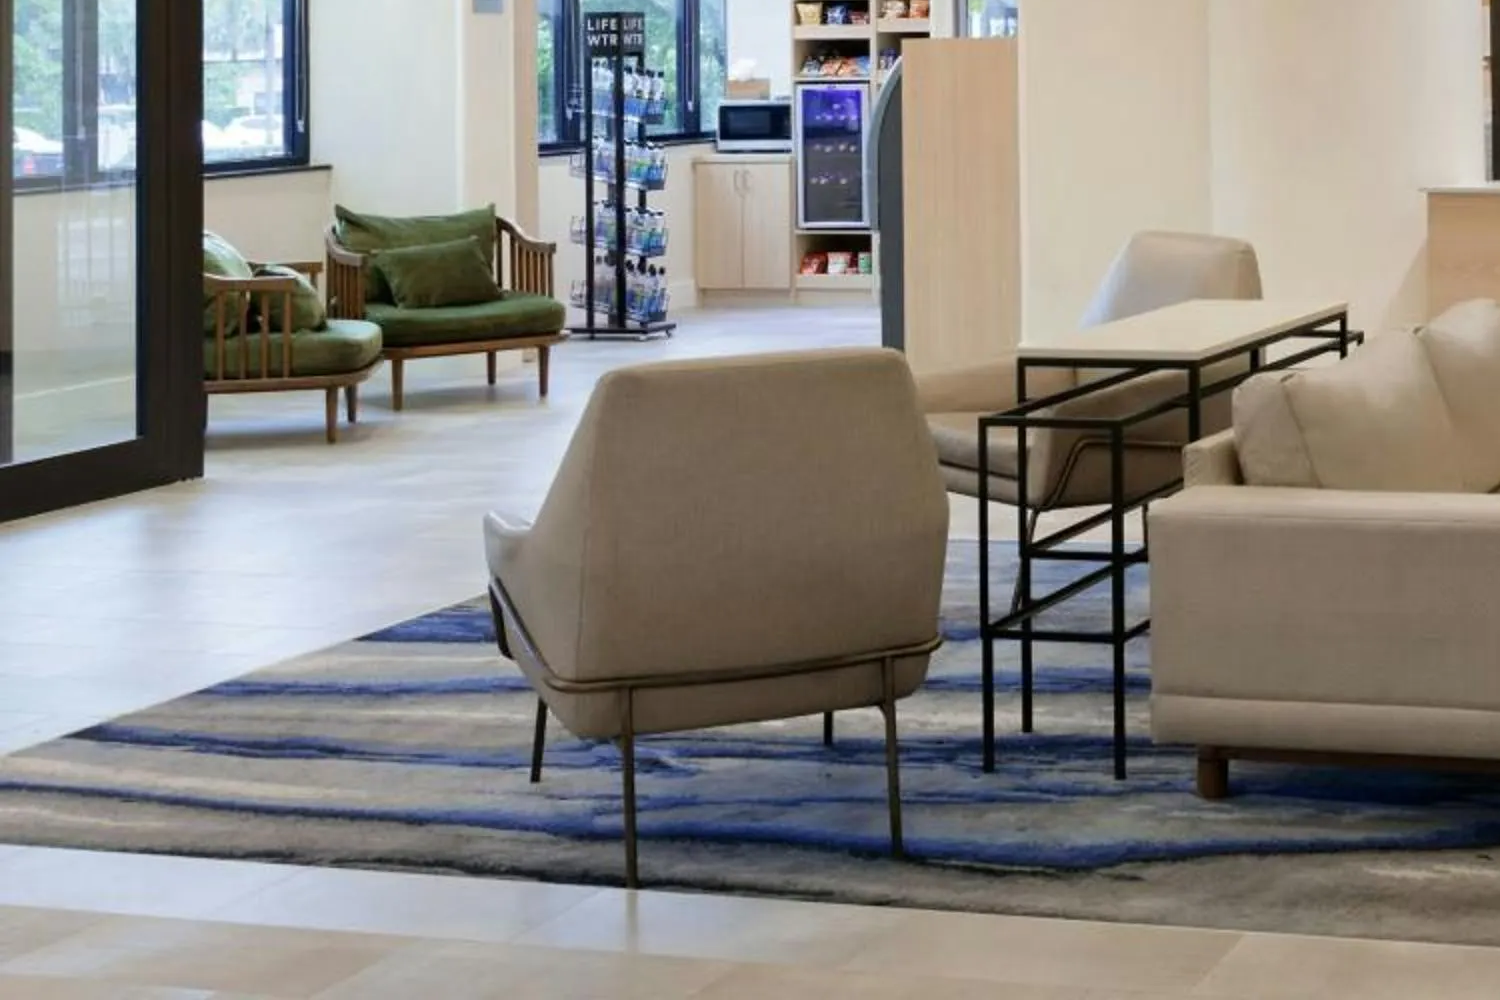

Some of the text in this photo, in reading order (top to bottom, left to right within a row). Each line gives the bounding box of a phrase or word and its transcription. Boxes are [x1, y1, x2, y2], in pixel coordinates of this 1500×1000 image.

[587, 18, 617, 31] LIFE
[623, 17, 643, 30] LIFE
[586, 34, 618, 47] WTR
